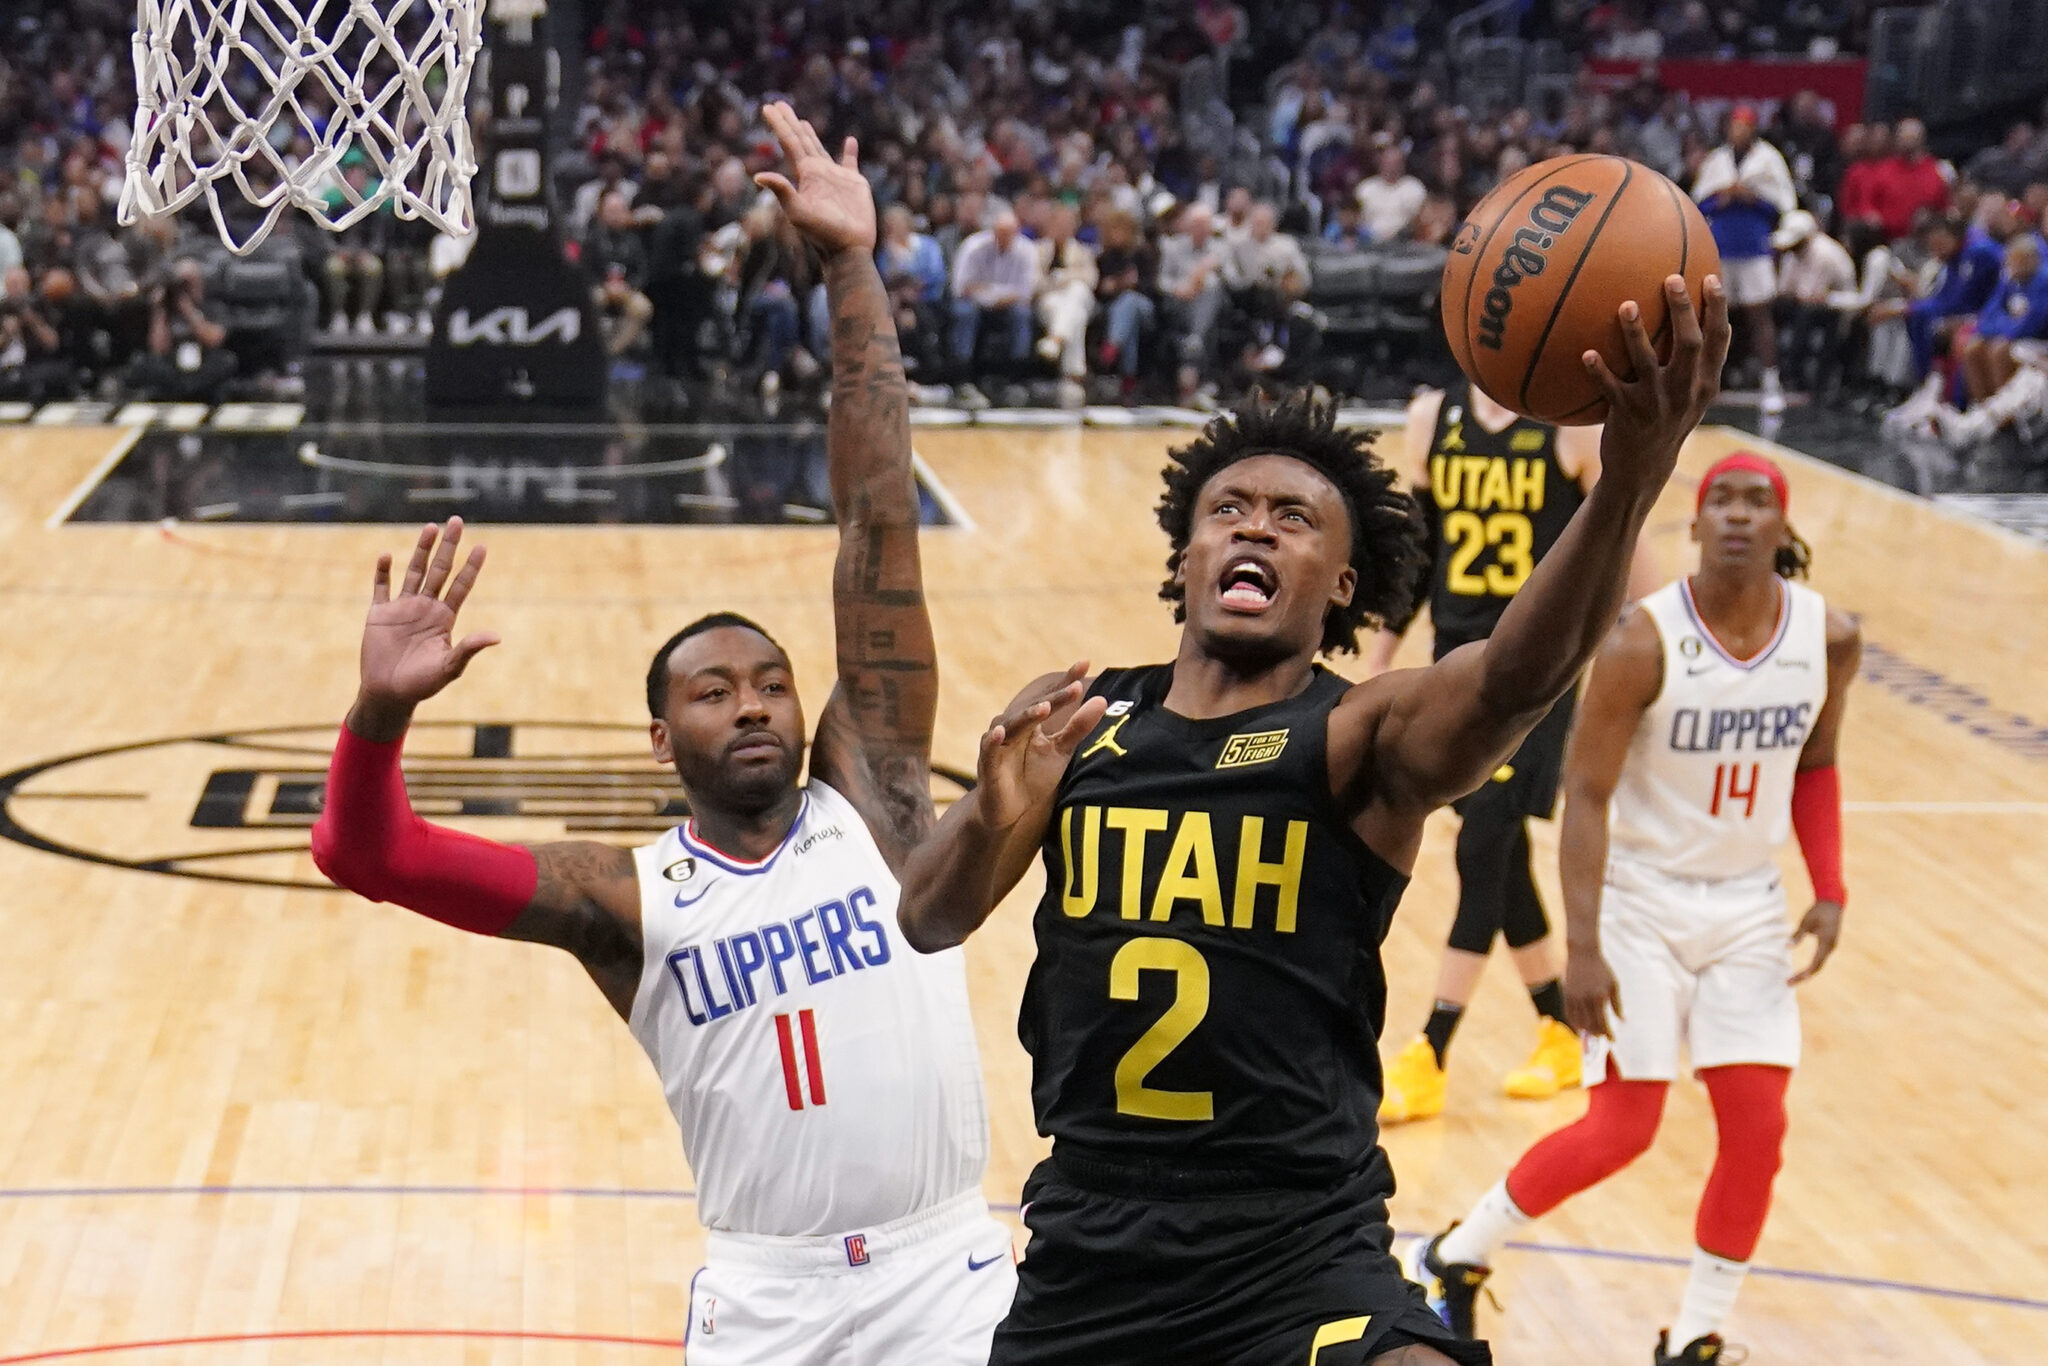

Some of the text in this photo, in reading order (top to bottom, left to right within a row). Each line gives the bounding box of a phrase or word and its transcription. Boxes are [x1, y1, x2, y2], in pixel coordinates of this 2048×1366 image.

[1478, 184, 1597, 350] Wilson
[1430, 454, 1547, 512] UTAH
[1444, 510, 1535, 596] 23
[1223, 738, 1248, 764] 5
[1243, 744, 1282, 761] FIGHT
[1670, 702, 1812, 753] CLIPPERS
[1710, 761, 1761, 819] 14
[793, 825, 844, 857] honey
[1062, 806, 1309, 933] UTAH
[665, 885, 893, 1027] CLIPPERS
[775, 1008, 827, 1111] 11
[1110, 937, 1214, 1121] 2
